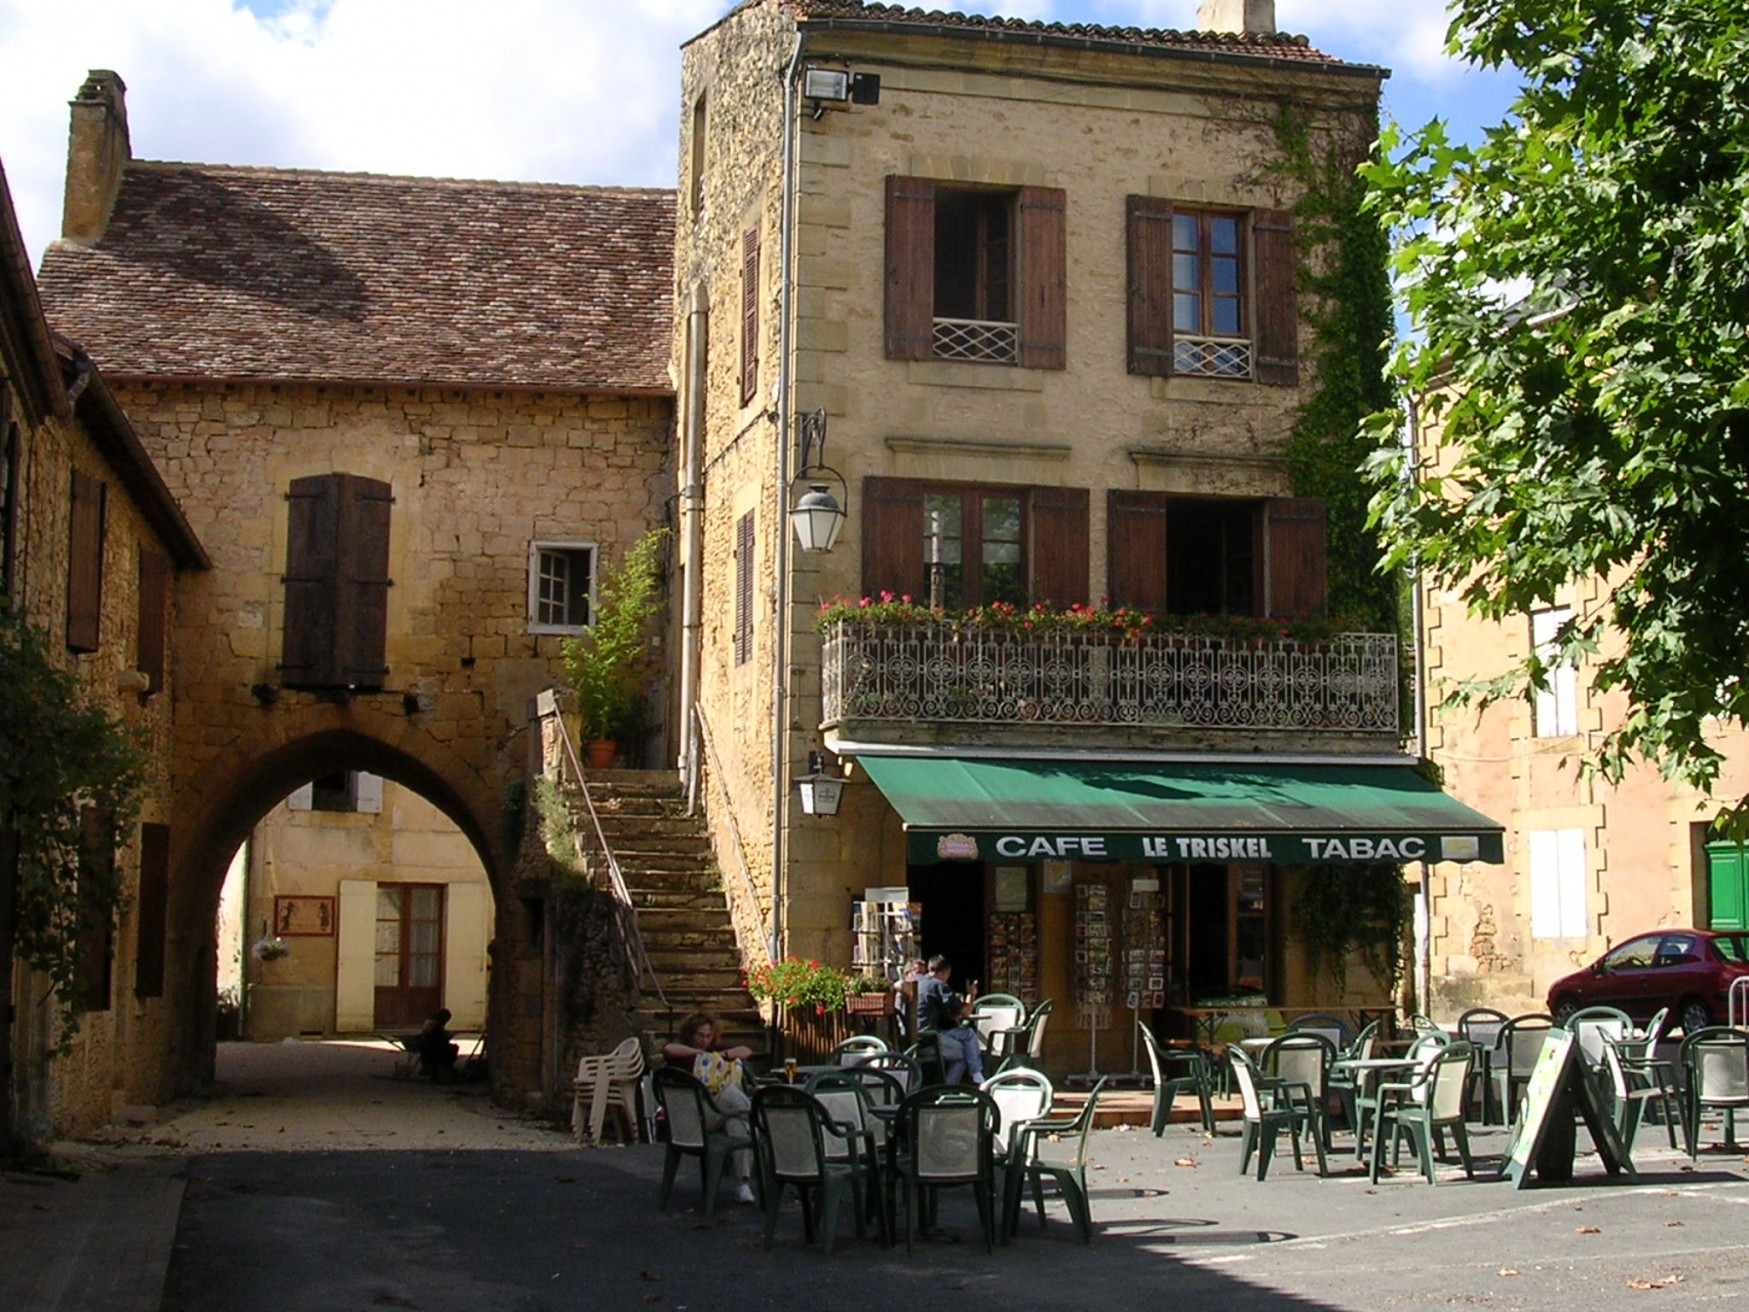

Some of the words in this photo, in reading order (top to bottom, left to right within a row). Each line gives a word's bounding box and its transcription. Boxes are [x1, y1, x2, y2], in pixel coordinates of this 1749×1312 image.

[995, 836, 1107, 857] CAFE
[1142, 837, 1168, 857] LE
[1176, 837, 1272, 859] TRISKEL
[1301, 837, 1426, 859] TABAC
